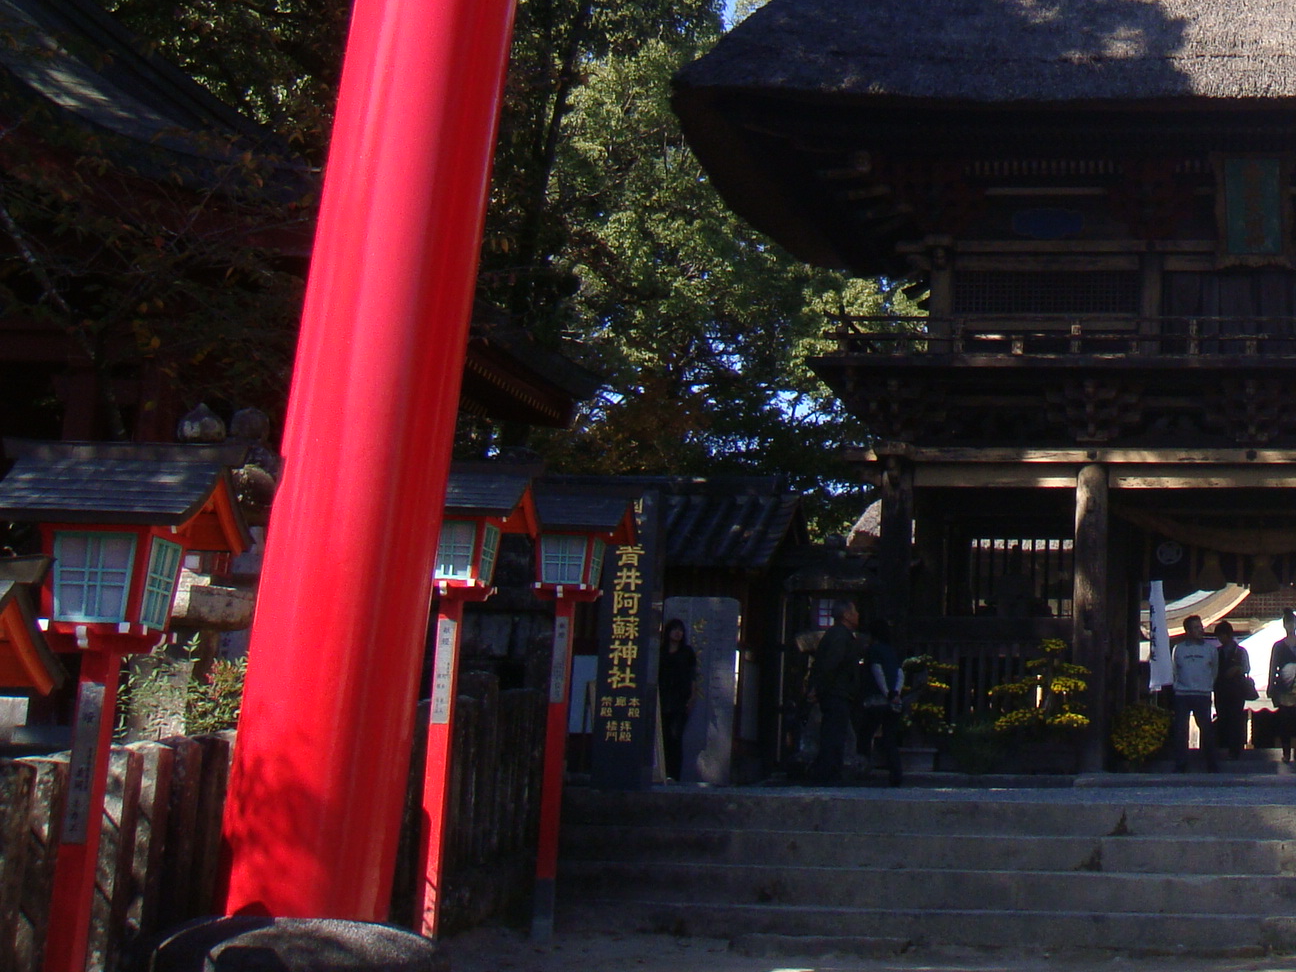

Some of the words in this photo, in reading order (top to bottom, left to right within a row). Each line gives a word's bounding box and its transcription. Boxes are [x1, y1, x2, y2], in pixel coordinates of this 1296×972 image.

[607, 544, 646, 689] 青井阿蘇神社
